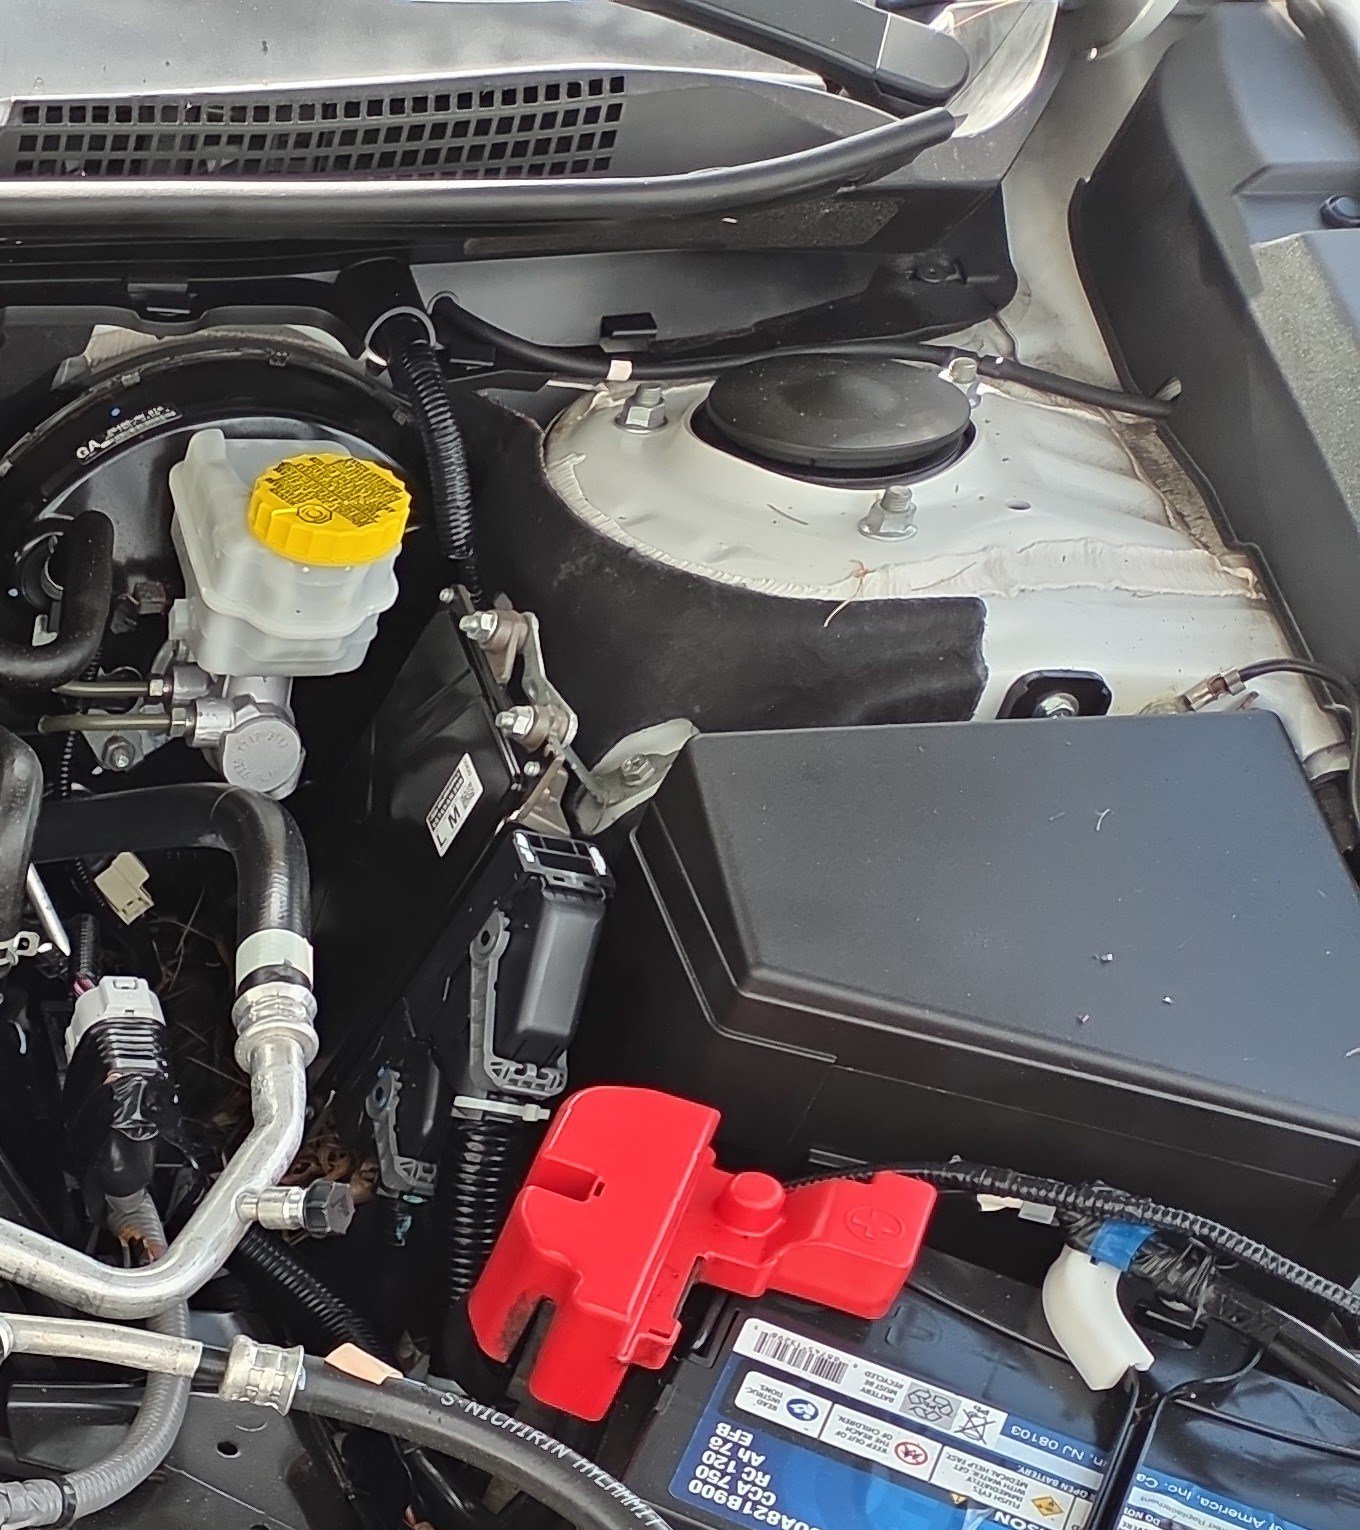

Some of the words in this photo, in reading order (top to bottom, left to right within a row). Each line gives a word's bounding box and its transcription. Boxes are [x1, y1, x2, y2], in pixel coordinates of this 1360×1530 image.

[447, 804, 461, 830] M
[863, 1370, 903, 1389] RECYCLED
[864, 1378, 874, 1387] BE
[859, 1385, 894, 1403] BATTERY
[875, 1383, 897, 1395] MUST
[755, 1398, 778, 1411] READ
[714, 1421, 753, 1447] EFB
[834, 1429, 846, 1438] OF
[844, 1425, 872, 1440] REACH
[847, 1434, 865, 1445] OUT
[880, 1431, 893, 1440] OF
[1010, 1424, 1059, 1450] 08103
[866, 1441, 887, 1454] KEEP
[873, 1436, 889, 1447] THE
[736, 1446, 765, 1466] Ah
[1061, 1443, 1084, 1460] NJ
[700, 1449, 735, 1474] 120
[953, 1463, 969, 1473] GET
[966, 1460, 989, 1473] HELP
[693, 1463, 731, 1489] 750
[740, 1465, 770, 1487] RC
[991, 1469, 1028, 1488] MEDICAL
[736, 1479, 777, 1507] CCA
[965, 1475, 1023, 1502] IMMEDIATELY
[1002, 1481, 1025, 1495] WITH
[1059, 1481, 1088, 1498] OPEN
[1162, 1481, 1192, 1500] Inc.
[993, 1494, 1020, 1509] FLUSH
[1144, 1513, 1160, 1525] DO
